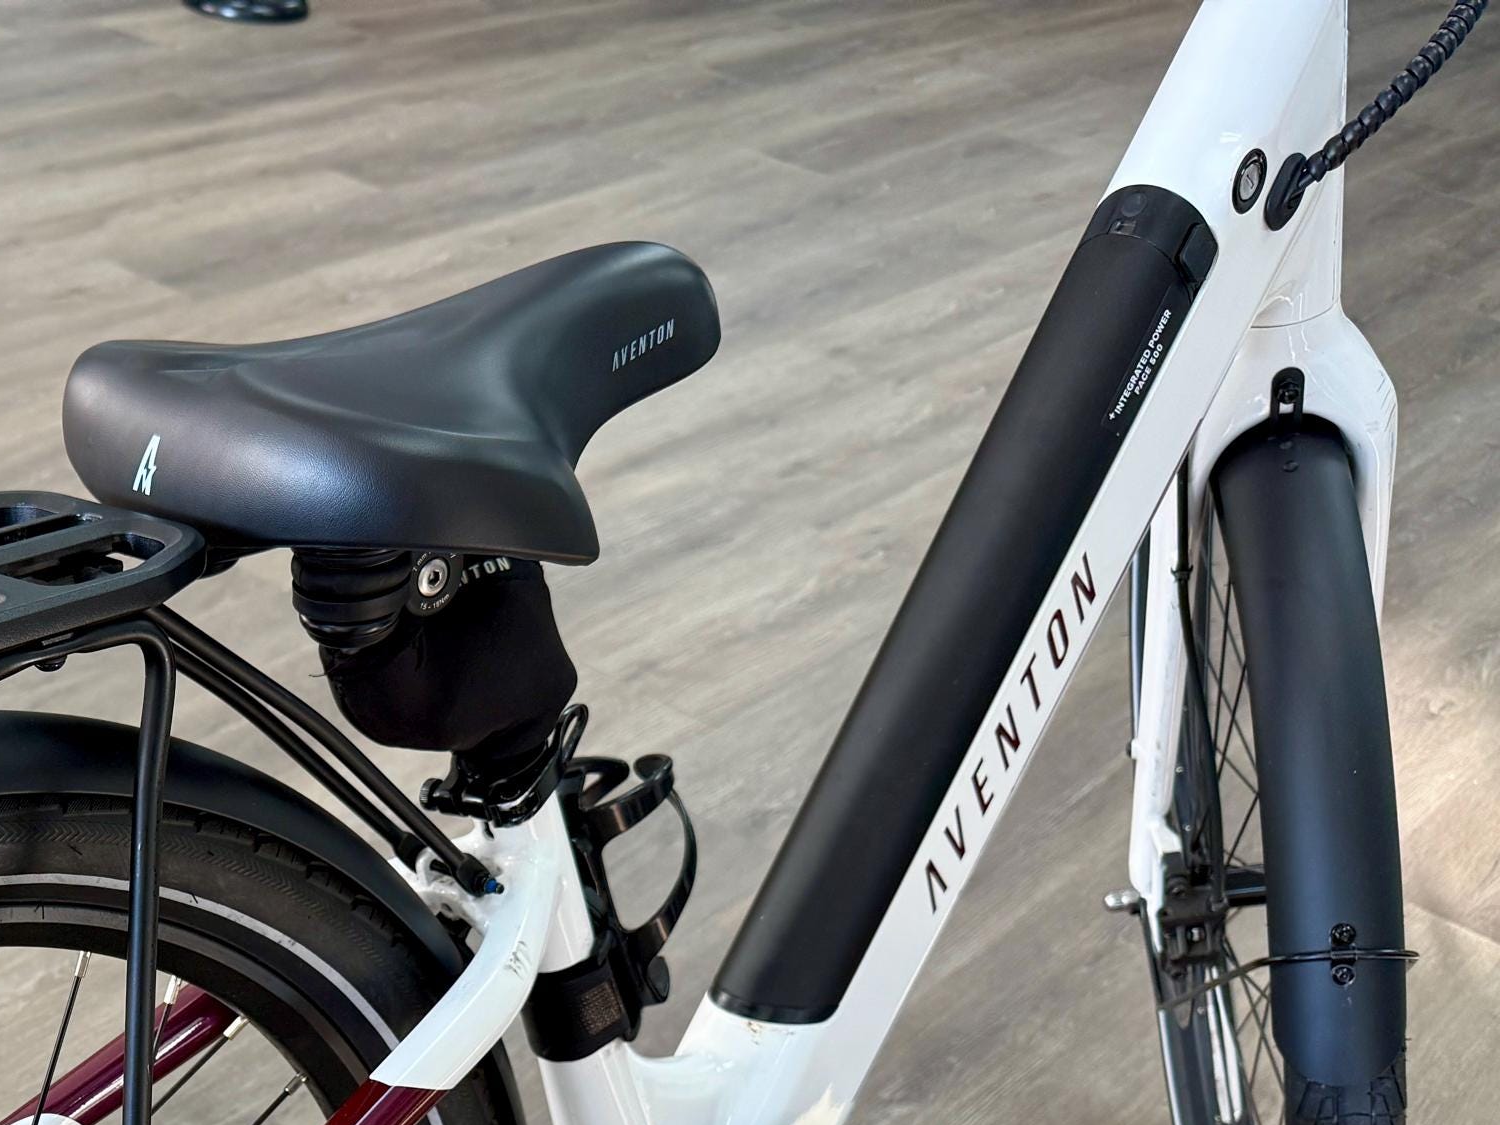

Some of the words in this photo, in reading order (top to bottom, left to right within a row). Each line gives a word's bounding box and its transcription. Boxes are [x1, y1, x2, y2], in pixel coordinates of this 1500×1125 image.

[612, 318, 675, 372] AVENTON
[1114, 348, 1151, 414] INTEGRATED
[1148, 309, 1172, 348] POWER
[1134, 366, 1152, 395] PACE
[1149, 343, 1163, 366] 500
[924, 551, 1097, 915] AVENTON
